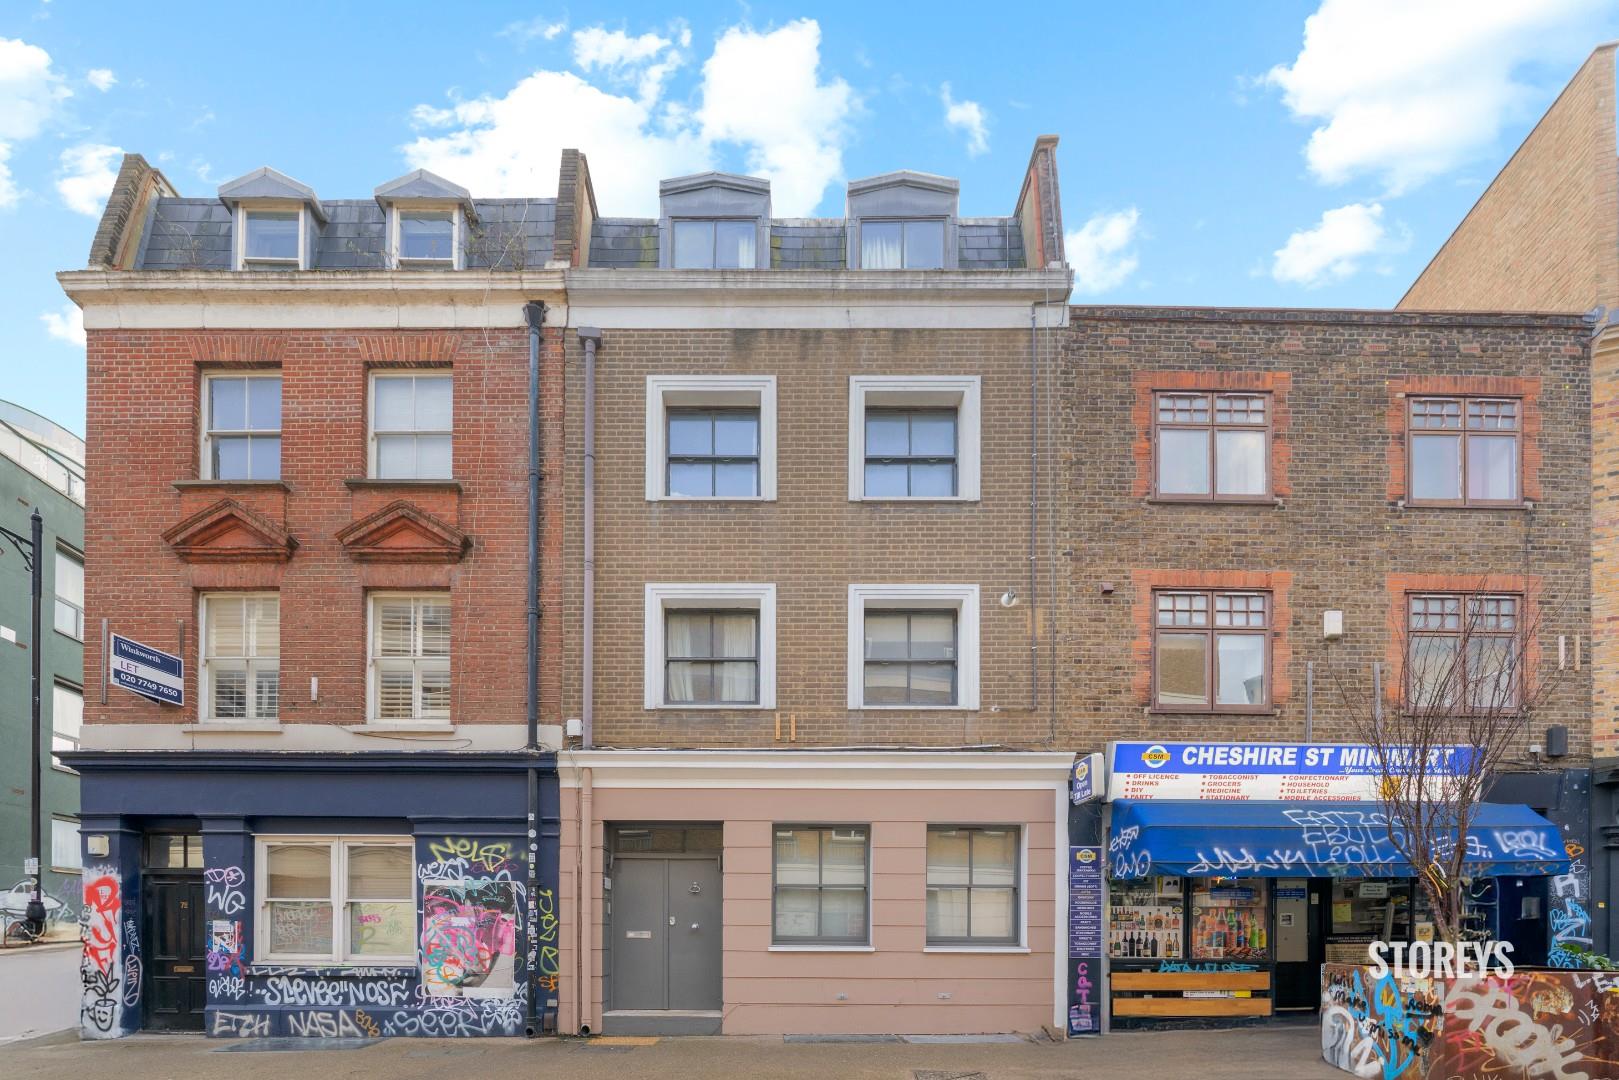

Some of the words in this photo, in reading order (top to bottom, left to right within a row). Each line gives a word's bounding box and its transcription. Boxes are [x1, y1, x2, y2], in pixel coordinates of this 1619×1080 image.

[120, 642, 161, 664] Winkworth
[120, 660, 139, 674] LET
[120, 673, 136, 684] 020
[138, 678, 158, 691] 7749
[158, 685, 178, 697] 7650
[1147, 752, 1166, 761] CSM
[1182, 746, 1298, 766] CHESHIRE
[1304, 747, 1336, 767] ST
[1148, 773, 1181, 781] LICENCE
[288, 1009, 364, 1038] NASA
